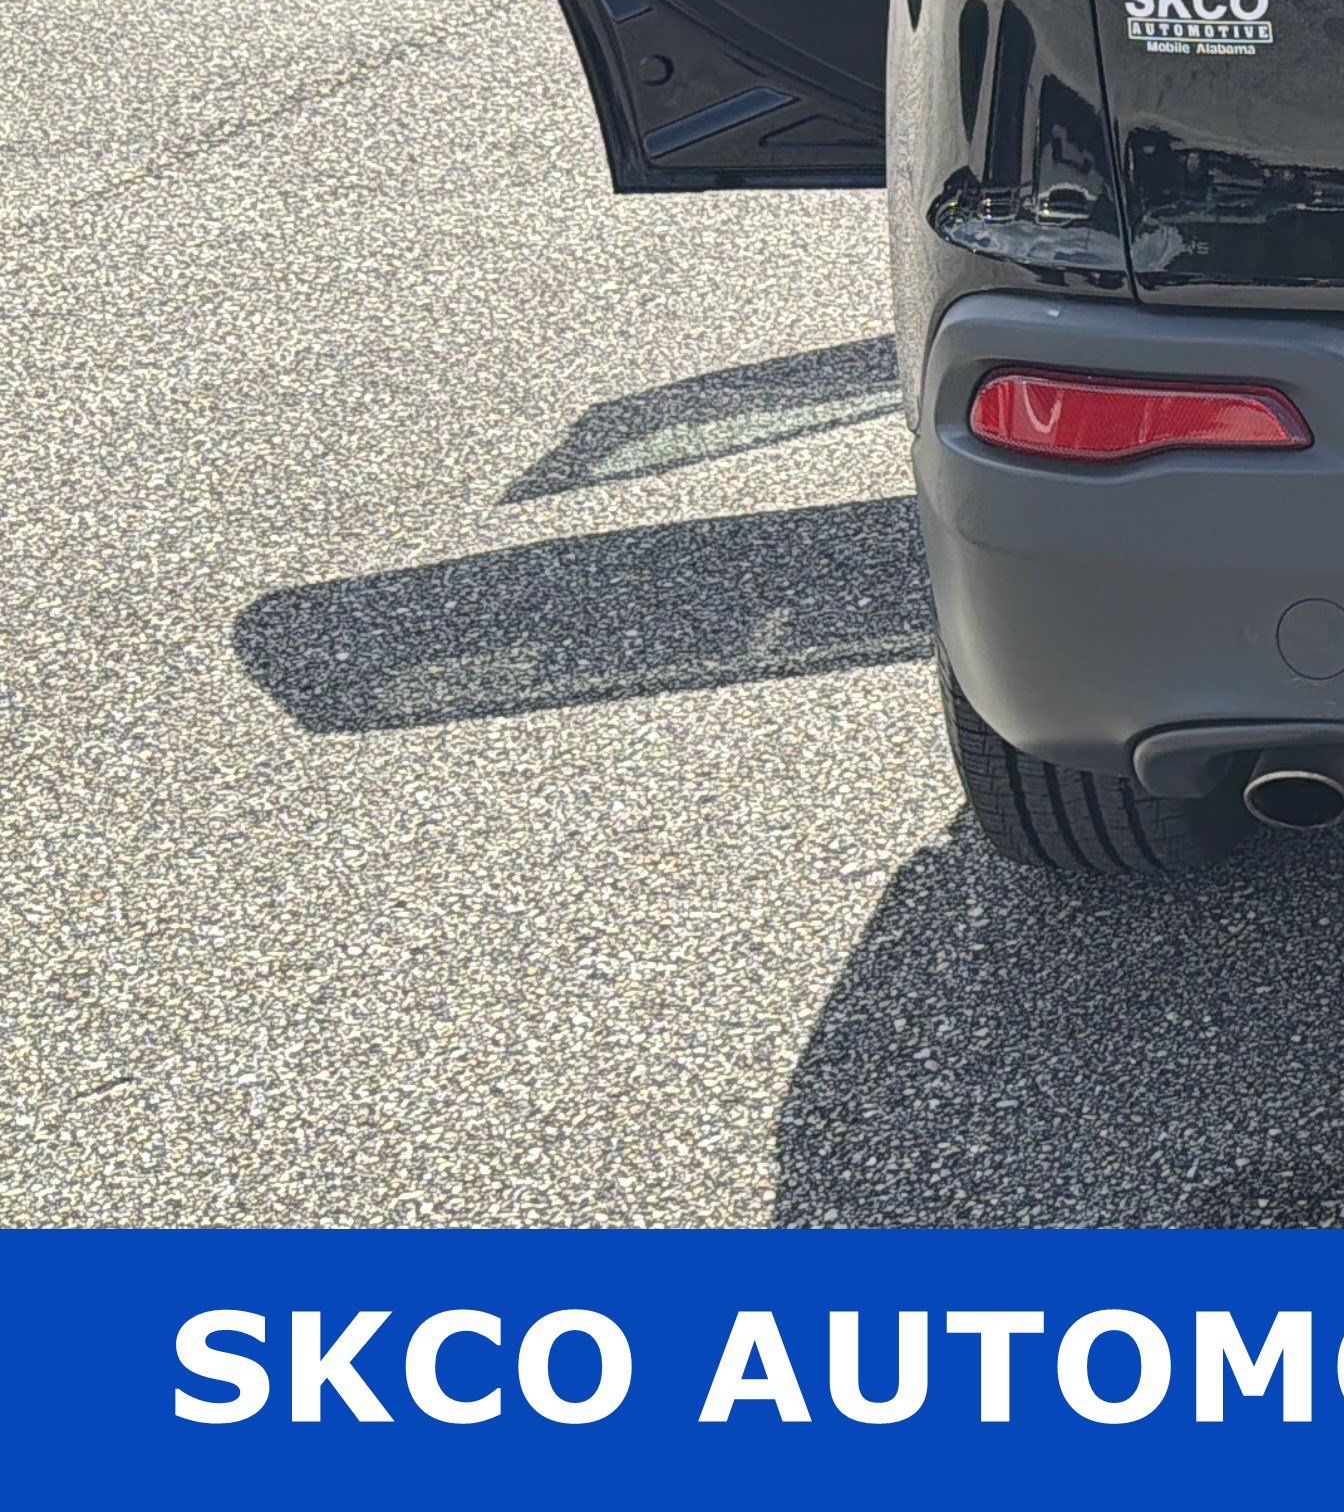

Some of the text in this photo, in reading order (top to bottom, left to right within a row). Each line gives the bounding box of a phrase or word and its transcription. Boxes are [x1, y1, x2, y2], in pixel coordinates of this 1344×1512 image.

[1131, 21, 1270, 39] AUTOMOTIVE
[1146, 40, 1256, 55] Mobile Alabama
